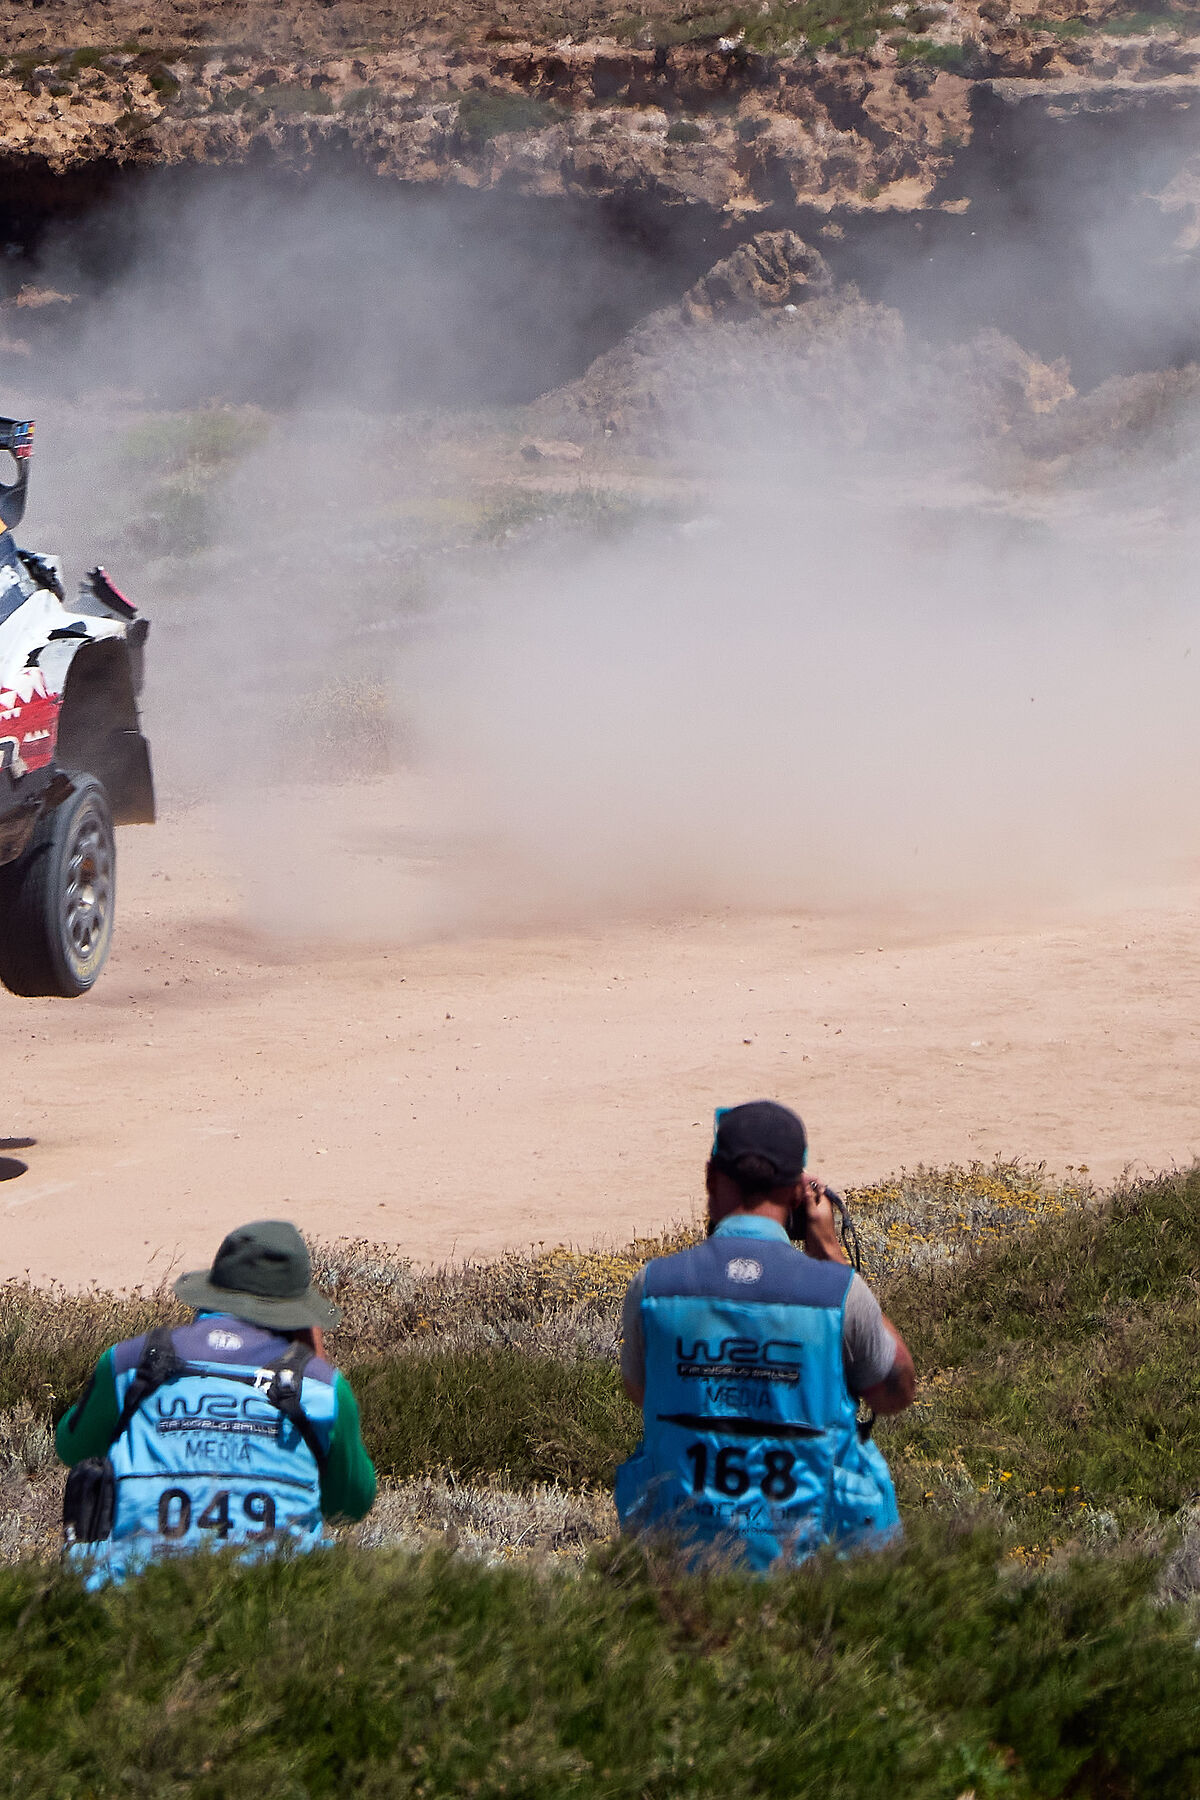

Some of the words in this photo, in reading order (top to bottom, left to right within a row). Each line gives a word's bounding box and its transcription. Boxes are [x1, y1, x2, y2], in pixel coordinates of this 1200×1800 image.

[676, 1334, 804, 1368] WRC
[157, 1394, 280, 1421] WRC
[185, 1438, 251, 1463] MEDIA
[686, 1443, 798, 1501] 168
[157, 1487, 276, 1541] 049
